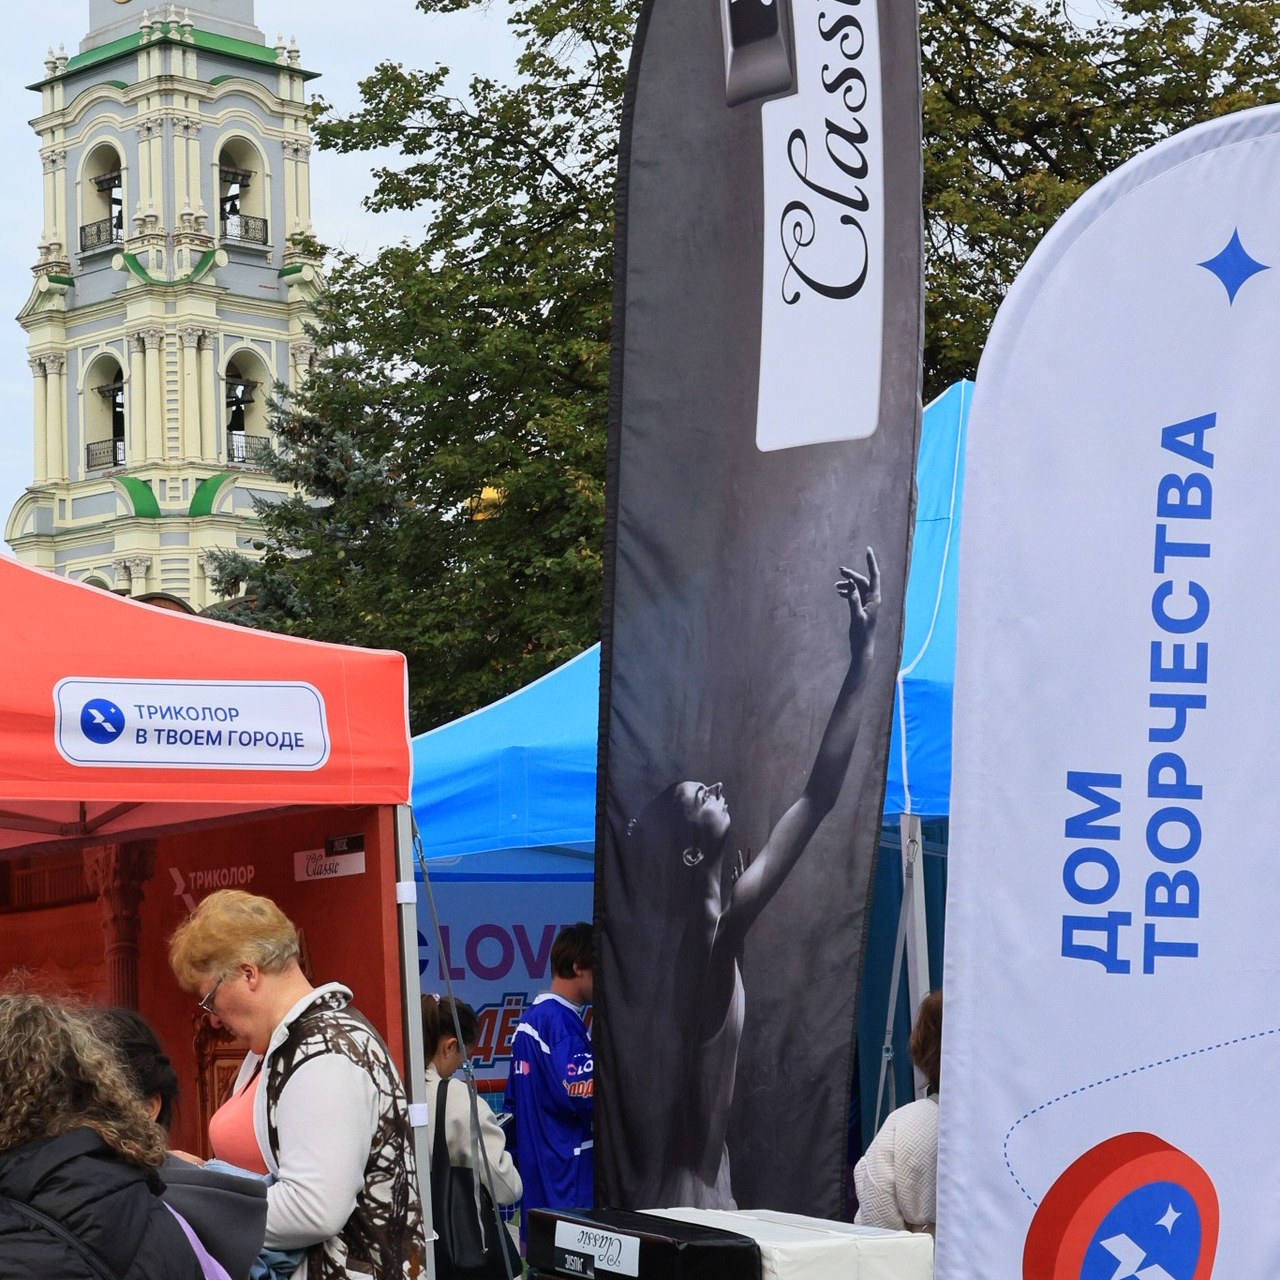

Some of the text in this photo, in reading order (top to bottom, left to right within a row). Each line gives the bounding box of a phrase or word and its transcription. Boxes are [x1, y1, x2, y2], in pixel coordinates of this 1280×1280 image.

[1144, 412, 1217, 975] ТВОРЧЕСТВА
[134, 705, 239, 722] ТРИКОЛОР
[135, 729, 304, 750] В ТВОЕМ ГОРОДЕ
[306, 853, 340, 877] Classic
[1062, 770, 1131, 975] ДОМ
[189, 865, 255, 890] ТРИКОЛОР
[577, 1230, 622, 1267] Classic
[565, 1255, 583, 1272] MUSIC
